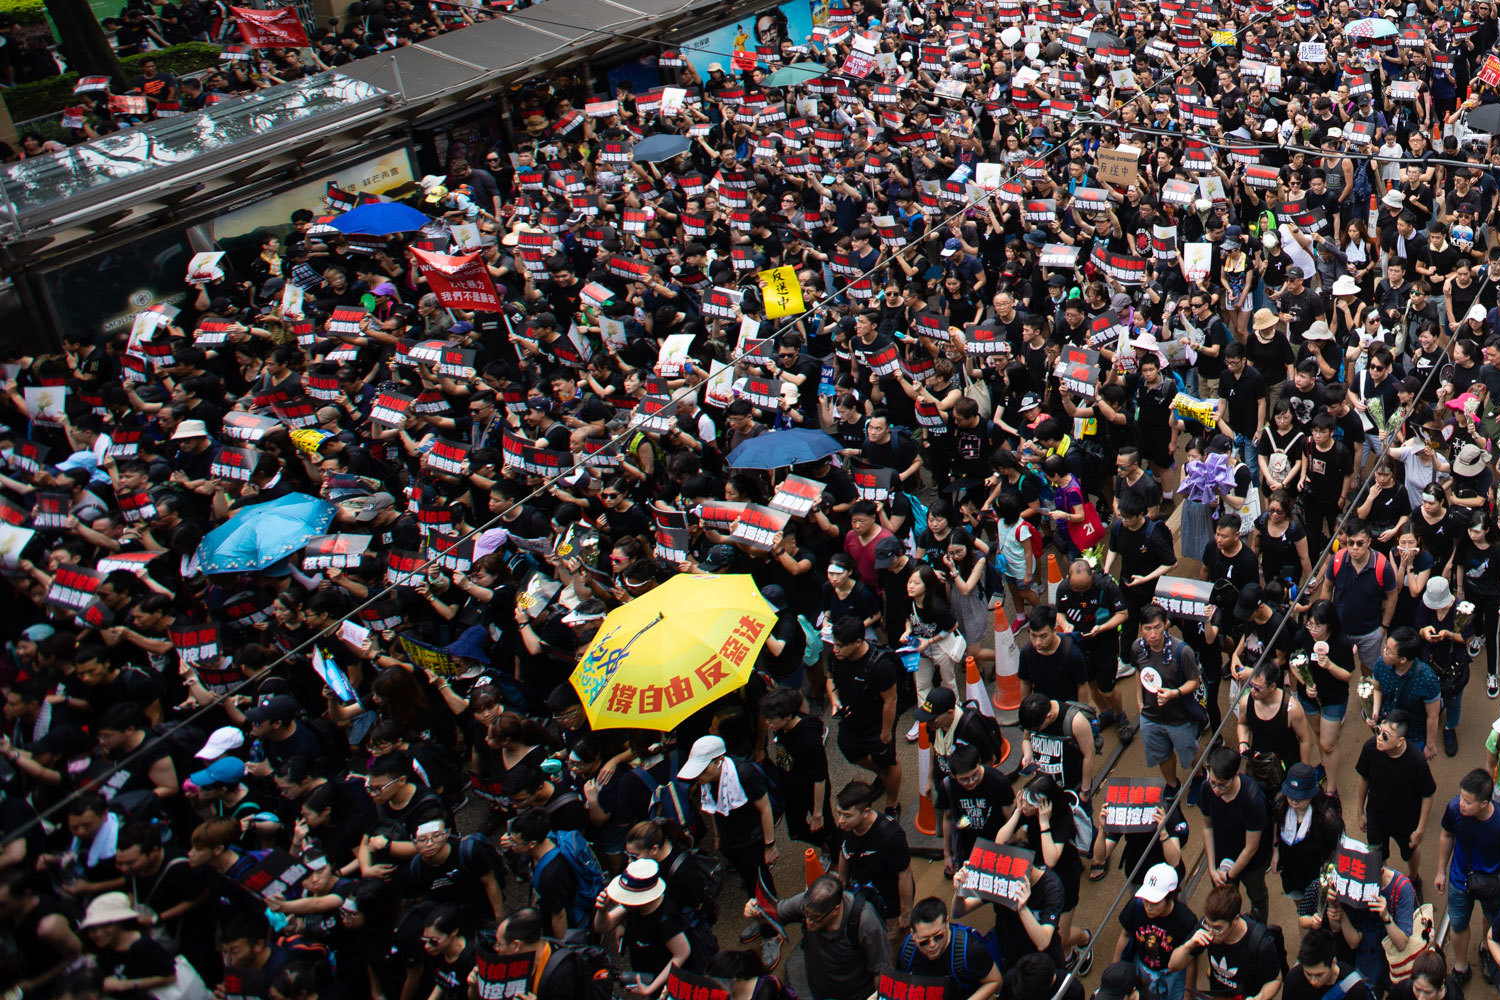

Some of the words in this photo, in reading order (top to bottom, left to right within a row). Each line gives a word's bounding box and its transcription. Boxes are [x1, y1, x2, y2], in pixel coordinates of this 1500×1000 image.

[847, 62, 868, 73] KILLING
[851, 57, 866, 66] STOP
[1100, 162, 1128, 178] 反送中
[772, 268, 791, 311] 反送中
[441, 292, 496, 305] 我們不是暴徒
[975, 330, 994, 341] 學生
[965, 341, 1007, 353] 沒有暴動
[855, 473, 876, 486] 學生
[1083, 522, 1095, 536] 21
[607, 676, 694, 714] 撐自由
[695, 615, 765, 690] 反惡法
[960, 799, 975, 808] TELL
[976, 799, 987, 808] ME
[1105, 785, 1162, 806] 問責槍擊
[966, 807, 982, 817] YOUR
[1104, 804, 1160, 825] 撤回控罪
[968, 847, 1029, 880] 問責槍擊
[1338, 851, 1366, 879] 學生
[961, 868, 1024, 902] 撤回控罪
[879, 975, 944, 1000] 問責槍擊
[1215, 973, 1238, 989] adidas
